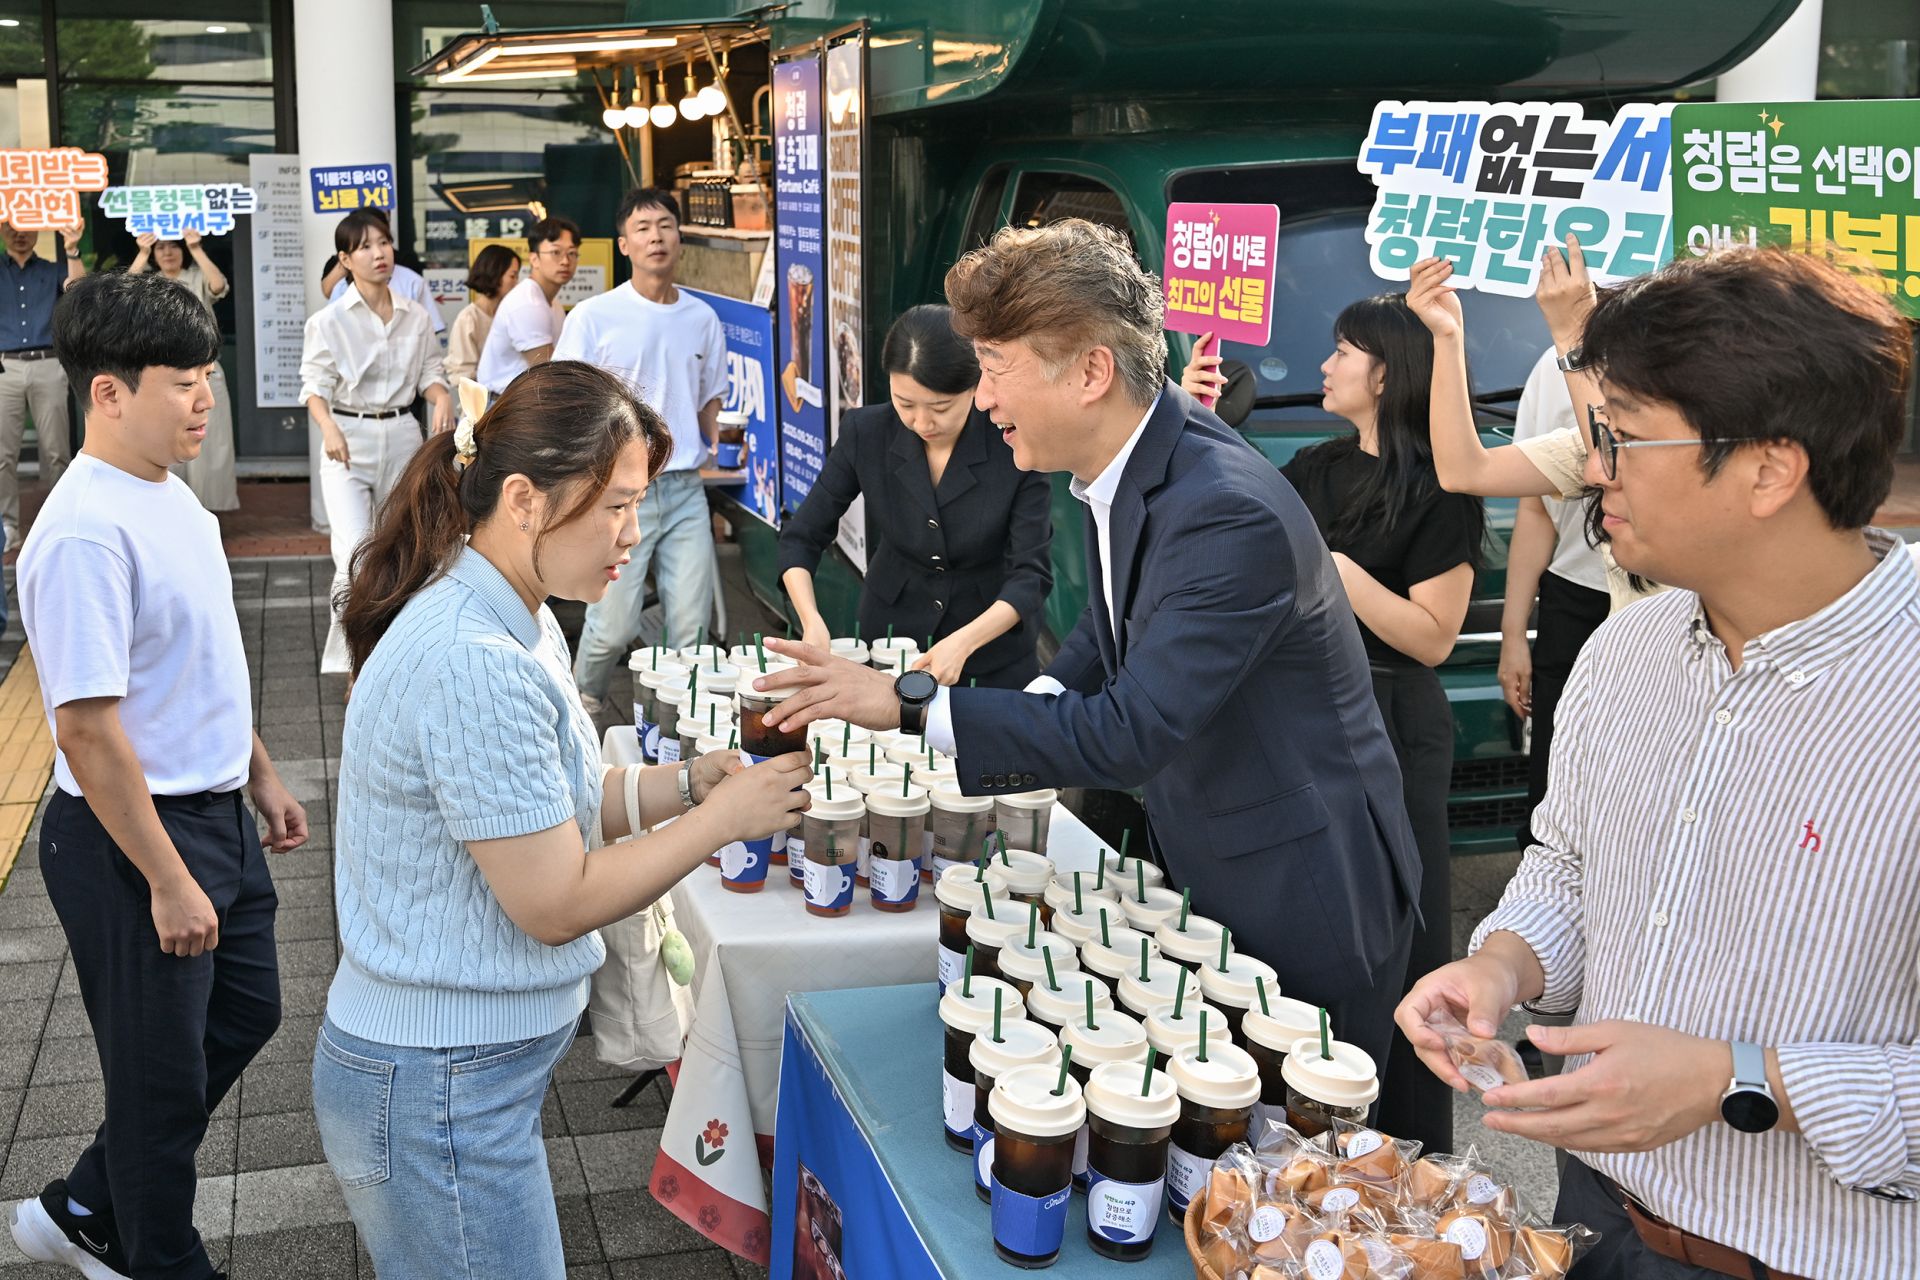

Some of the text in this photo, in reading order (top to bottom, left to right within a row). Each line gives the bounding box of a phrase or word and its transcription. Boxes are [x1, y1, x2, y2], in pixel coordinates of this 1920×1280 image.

[1366, 112, 1673, 199] 부패 없는 서
[1682, 129, 1802, 194] 청렴은
[205, 188, 253, 210] 없는
[318, 189, 359, 210] 뇌물
[777, 178, 802, 194] Fortune
[13, 193, 75, 224] 실현
[1172, 219, 1266, 273] 청렴이 바로
[1373, 192, 1548, 285] 청렴한
[429, 279, 467, 293] 보건소
[1167, 275, 1265, 325] 최고의 선물
